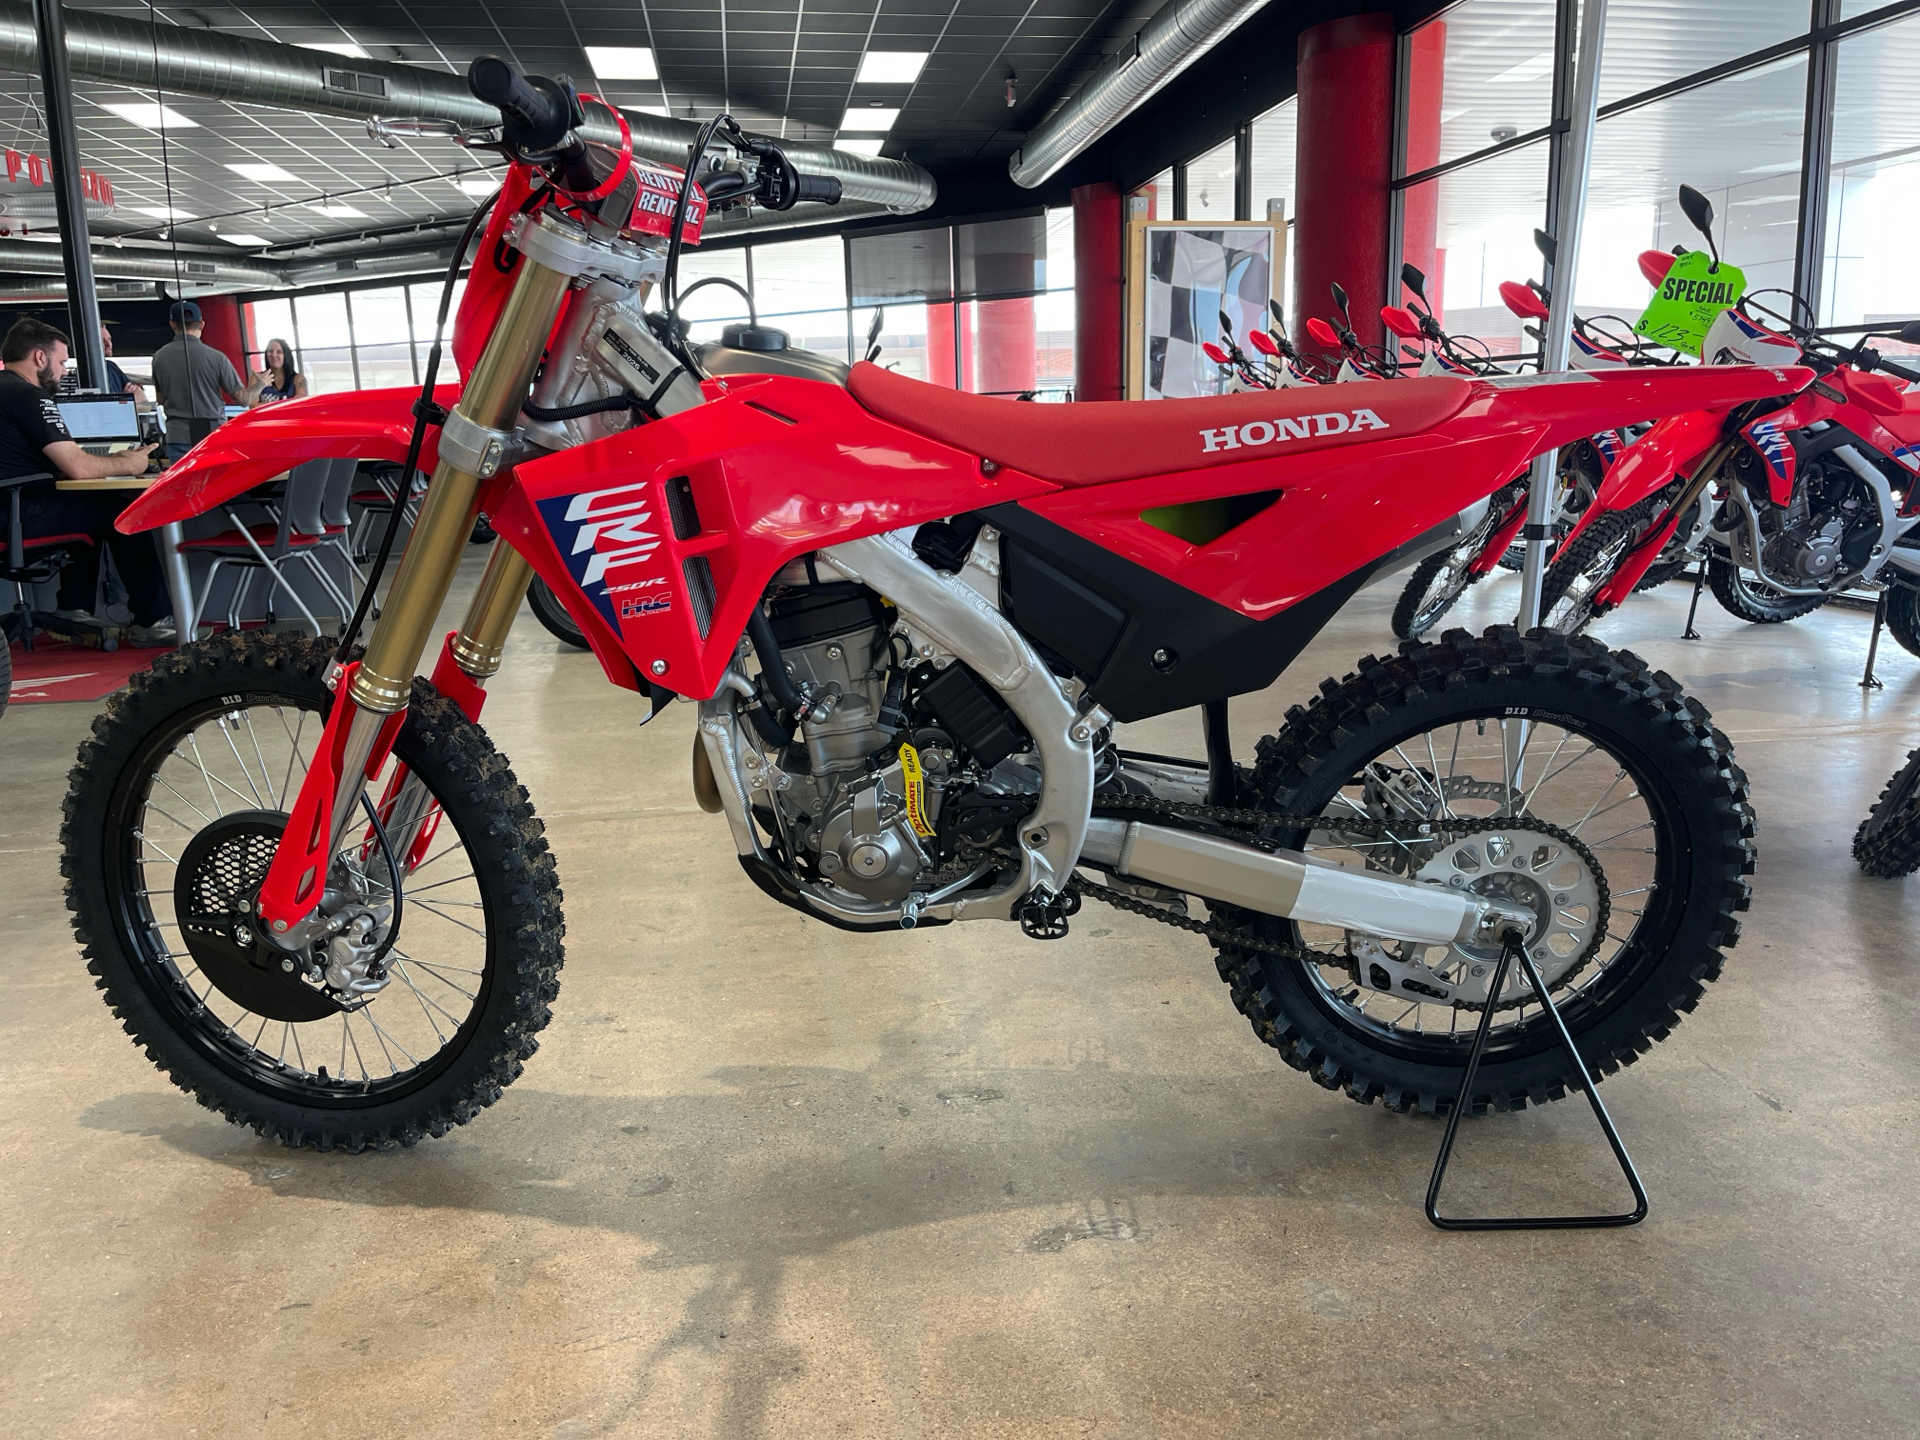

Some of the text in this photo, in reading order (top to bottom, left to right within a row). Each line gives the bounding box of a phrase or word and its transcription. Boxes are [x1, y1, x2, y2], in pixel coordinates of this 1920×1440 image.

[637, 190, 700, 225] RENTAL
[1662, 277, 1734, 304] SPECIAL
[622, 351, 640, 371] 2026
[1199, 408, 1390, 453] HONDA
[1753, 420, 1791, 456] CRF
[564, 482, 662, 588] CRF
[599, 577, 669, 595] 250R
[622, 591, 671, 616] HRC
[904, 748, 916, 773] READY
